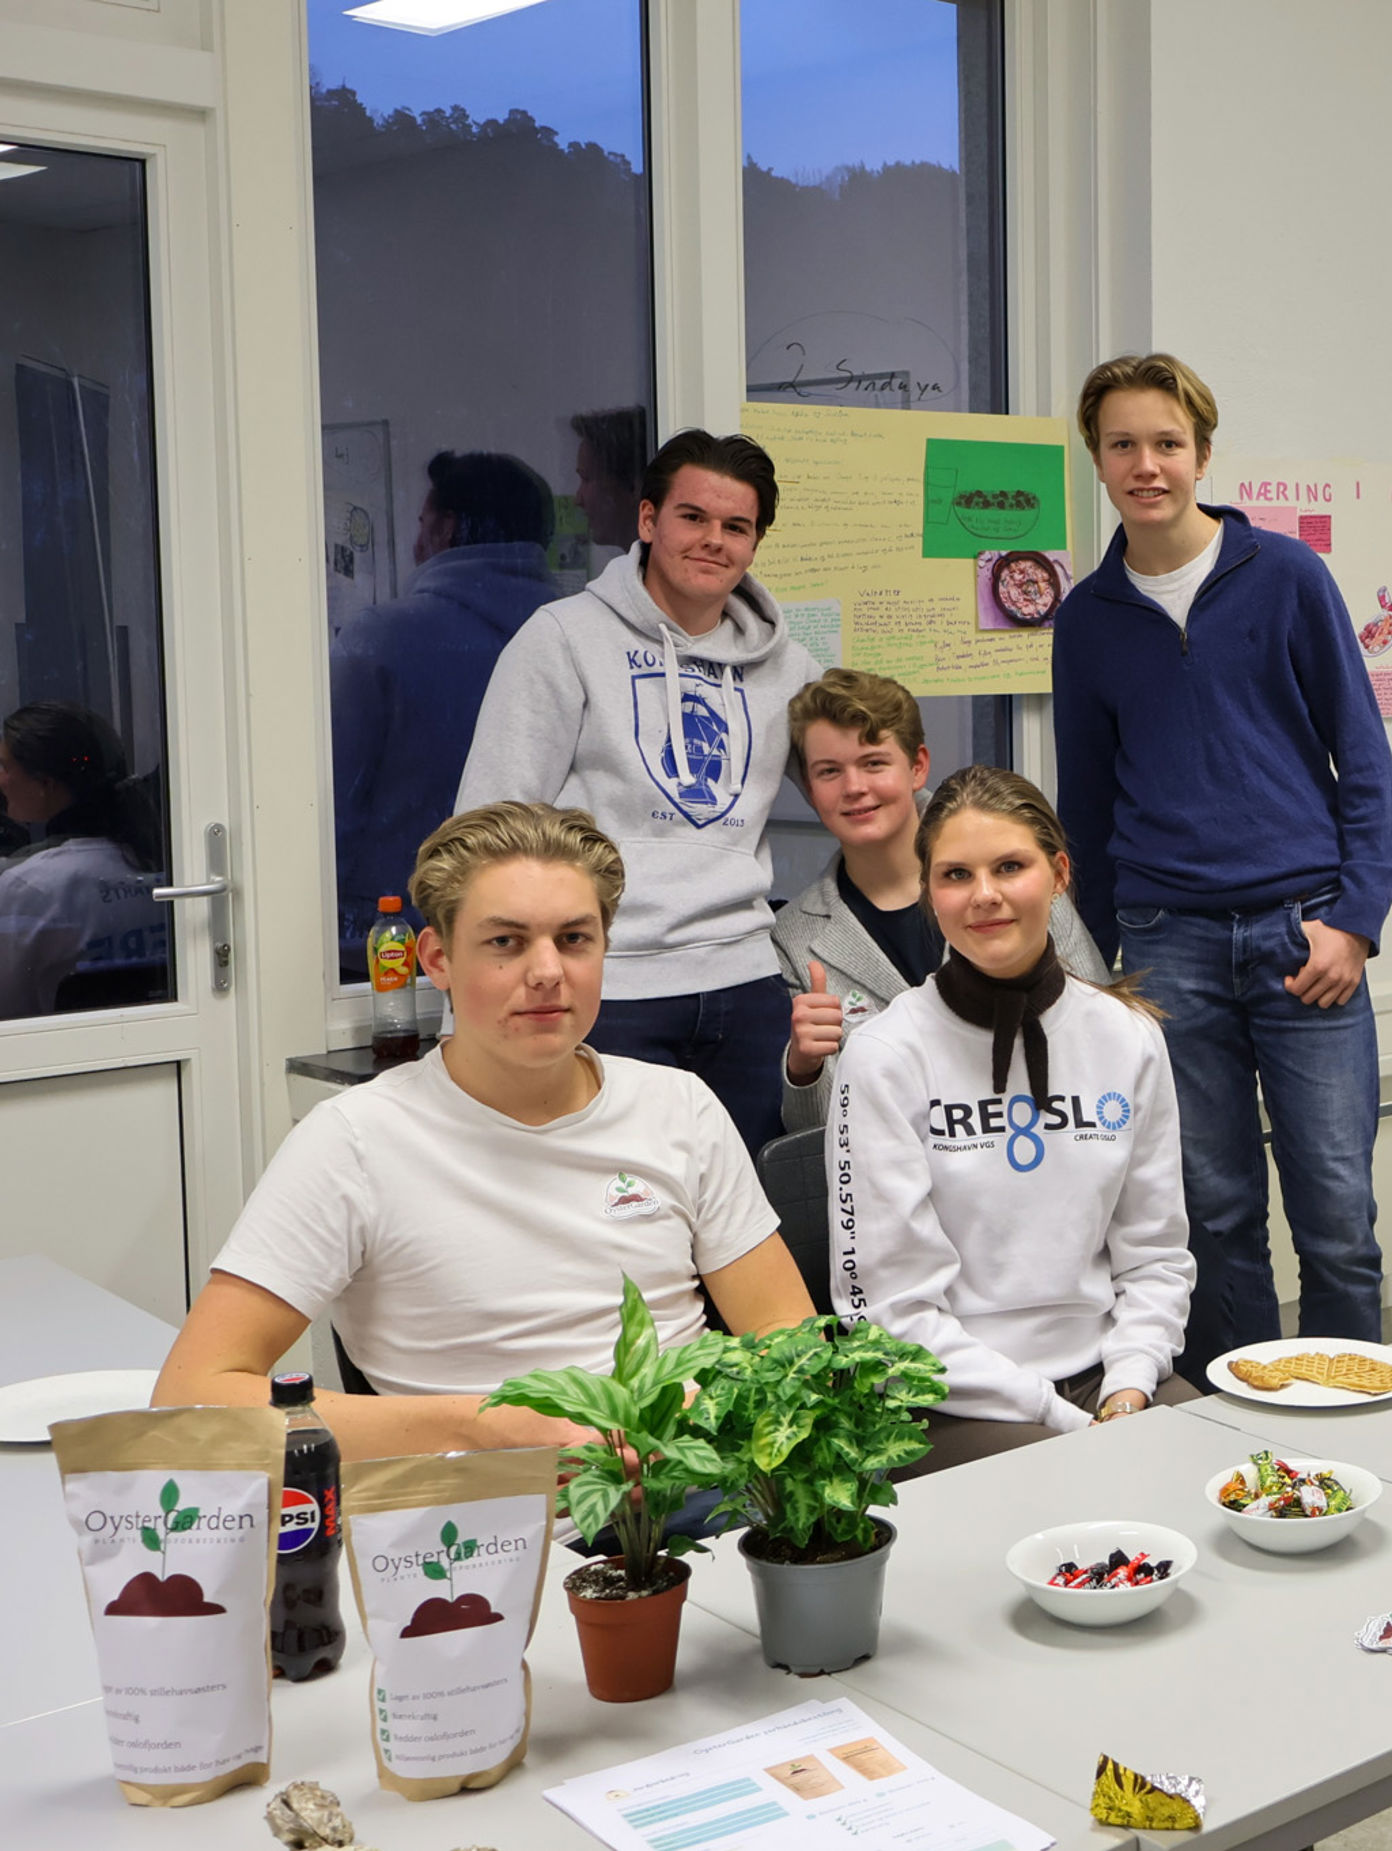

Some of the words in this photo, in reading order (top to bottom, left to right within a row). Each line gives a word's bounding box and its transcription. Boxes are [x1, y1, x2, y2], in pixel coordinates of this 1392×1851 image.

[1238, 481, 1333, 504] NÆRING
[85, 1506, 256, 1539] OysterGarden
[280, 1510, 316, 1527] PSI
[323, 1485, 337, 1537] MAX
[372, 1535, 527, 1577] OysterGarden
